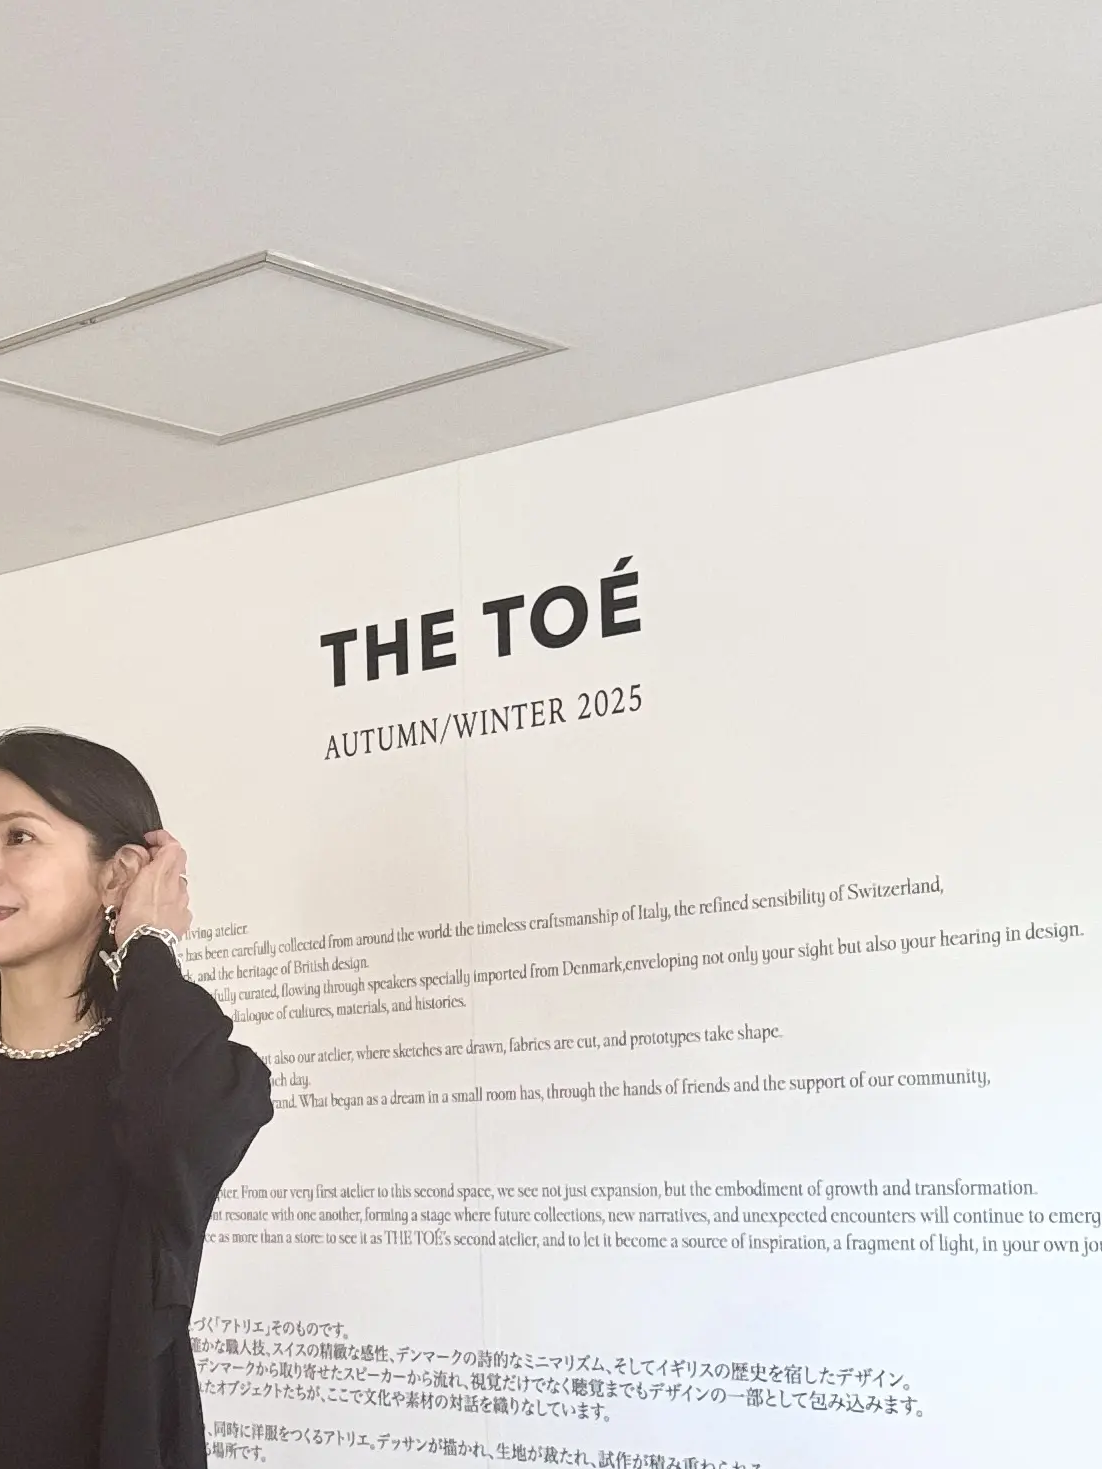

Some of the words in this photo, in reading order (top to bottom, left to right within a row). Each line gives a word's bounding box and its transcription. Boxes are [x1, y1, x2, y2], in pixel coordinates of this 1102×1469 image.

[320, 608, 457, 688] THE
[482, 555, 642, 658] TOÉ
[324, 697, 567, 761] AUTUMN/WINTER
[577, 684, 643, 721] 2025
[277, 934, 327, 953] collected
[326, 933, 354, 949] from
[354, 927, 395, 947] around
[396, 926, 415, 943] the
[454, 920, 475, 937] the
[476, 916, 527, 935] timeless
[528, 907, 619, 930] craftsmanship
[620, 904, 638, 921] of
[638, 901, 672, 922] Italy,
[673, 899, 696, 917] the
[698, 893, 749, 915] refined
[750, 887, 826, 909] sensibility
[828, 884, 846, 902] of
[846, 874, 944, 900] Switzerland,
[280, 959, 294, 975] of
[292, 956, 330, 974] British
[322, 976, 366, 996] through
[366, 973, 418, 995] speakers
[418, 967, 471, 991] specially
[472, 963, 528, 986] imported
[529, 962, 560, 978] from
[701, 951, 725, 965] not
[726, 944, 759, 966] only
[760, 947, 796, 965] your
[797, 938, 834, 960] sight
[836, 937, 862, 955] but
[864, 934, 897, 952] also
[900, 935, 937, 954] your
[940, 928, 1001, 947] hearing
[1004, 926, 1022, 942] in
[1024, 921, 1084, 941] design.
[275, 1004, 290, 1020] of
[390, 995, 413, 1013] and
[354, 1044, 391, 1060] where
[392, 1041, 443, 1059] sketches
[444, 1044, 464, 1056] are
[464, 1038, 507, 1056] drawn,
[508, 1035, 552, 1052] fabrics
[552, 1038, 575, 1050] are
[576, 1035, 601, 1050] cut,
[602, 1030, 628, 1048] and
[629, 1031, 702, 1051] prototypes
[704, 1024, 734, 1042] take
[736, 1022, 782, 1044] shape.
[298, 1092, 328, 1108] What
[330, 1091, 364, 1111] began
[366, 1095, 379, 1106] as
[380, 1095, 388, 1106] a
[388, 1088, 426, 1105] dream
[427, 1090, 440, 1104] in
[440, 1092, 449, 1103] a
[450, 1085, 483, 1103] small
[485, 1089, 517, 1101] room
[519, 1083, 544, 1102] has,
[546, 1081, 596, 1102] through
[598, 1080, 620, 1098] the
[622, 1078, 663, 1096] hands
[664, 1077, 680, 1094] of
[681, 1075, 731, 1095] friends
[732, 1074, 760, 1092] and
[762, 1073, 786, 1091] the
[788, 1075, 846, 1094] support
[848, 1070, 867, 1088] of
[867, 1074, 895, 1087] our
[896, 1070, 991, 1088] community,
[412, 1182, 455, 1199] second
[496, 1187, 516, 1198] we
[516, 1186, 539, 1198] see
[540, 1185, 562, 1197] not
[562, 1183, 588, 1202] just
[589, 1182, 662, 1202] expansion,
[664, 1180, 687, 1197] but
[688, 1180, 712, 1197] the
[714, 1179, 804, 1197] embodiment
[806, 1179, 824, 1196] of
[824, 1178, 879, 1201] growth
[882, 1178, 912, 1196] and
[914, 1178, 1038, 1196] transformation.
[420, 1210, 452, 1226] stage
[452, 1205, 492, 1222] where
[494, 1205, 532, 1222] future
[532, 1205, 606, 1225] collections,
[606, 1210, 636, 1222] new
[638, 1207, 711, 1225] narratives,
[712, 1205, 740, 1223] and
[742, 1205, 828, 1228] unexpected
[830, 1209, 916, 1223] encounters
[919, 1205, 950, 1223] will
[952, 1207, 1024, 1223] continue
[1028, 1209, 1045, 1223] to
[1048, 1211, 1102, 1228] emerg
[382, 1229, 413, 1246] THE
[452, 1229, 497, 1246] second
[498, 1230, 540, 1248] atelier,
[541, 1230, 566, 1247] and
[567, 1234, 581, 1247] to
[582, 1230, 600, 1247] let
[602, 1232, 612, 1248] it
[614, 1230, 668, 1248] become
[670, 1237, 679, 1248] a
[680, 1236, 728, 1249] source
[730, 1232, 747, 1249] of
[748, 1234, 830, 1254] inspiration,
[832, 1238, 842, 1250] a
[846, 1232, 916, 1255] fragment
[918, 1233, 936, 1251] of
[938, 1233, 979, 1256] light,
[982, 1235, 998, 1252] in
[1002, 1239, 1040, 1256] your
[1042, 1240, 1080, 1252] own
[191, 1316, 349, 1340] づく「アトリエ」そのものです。
